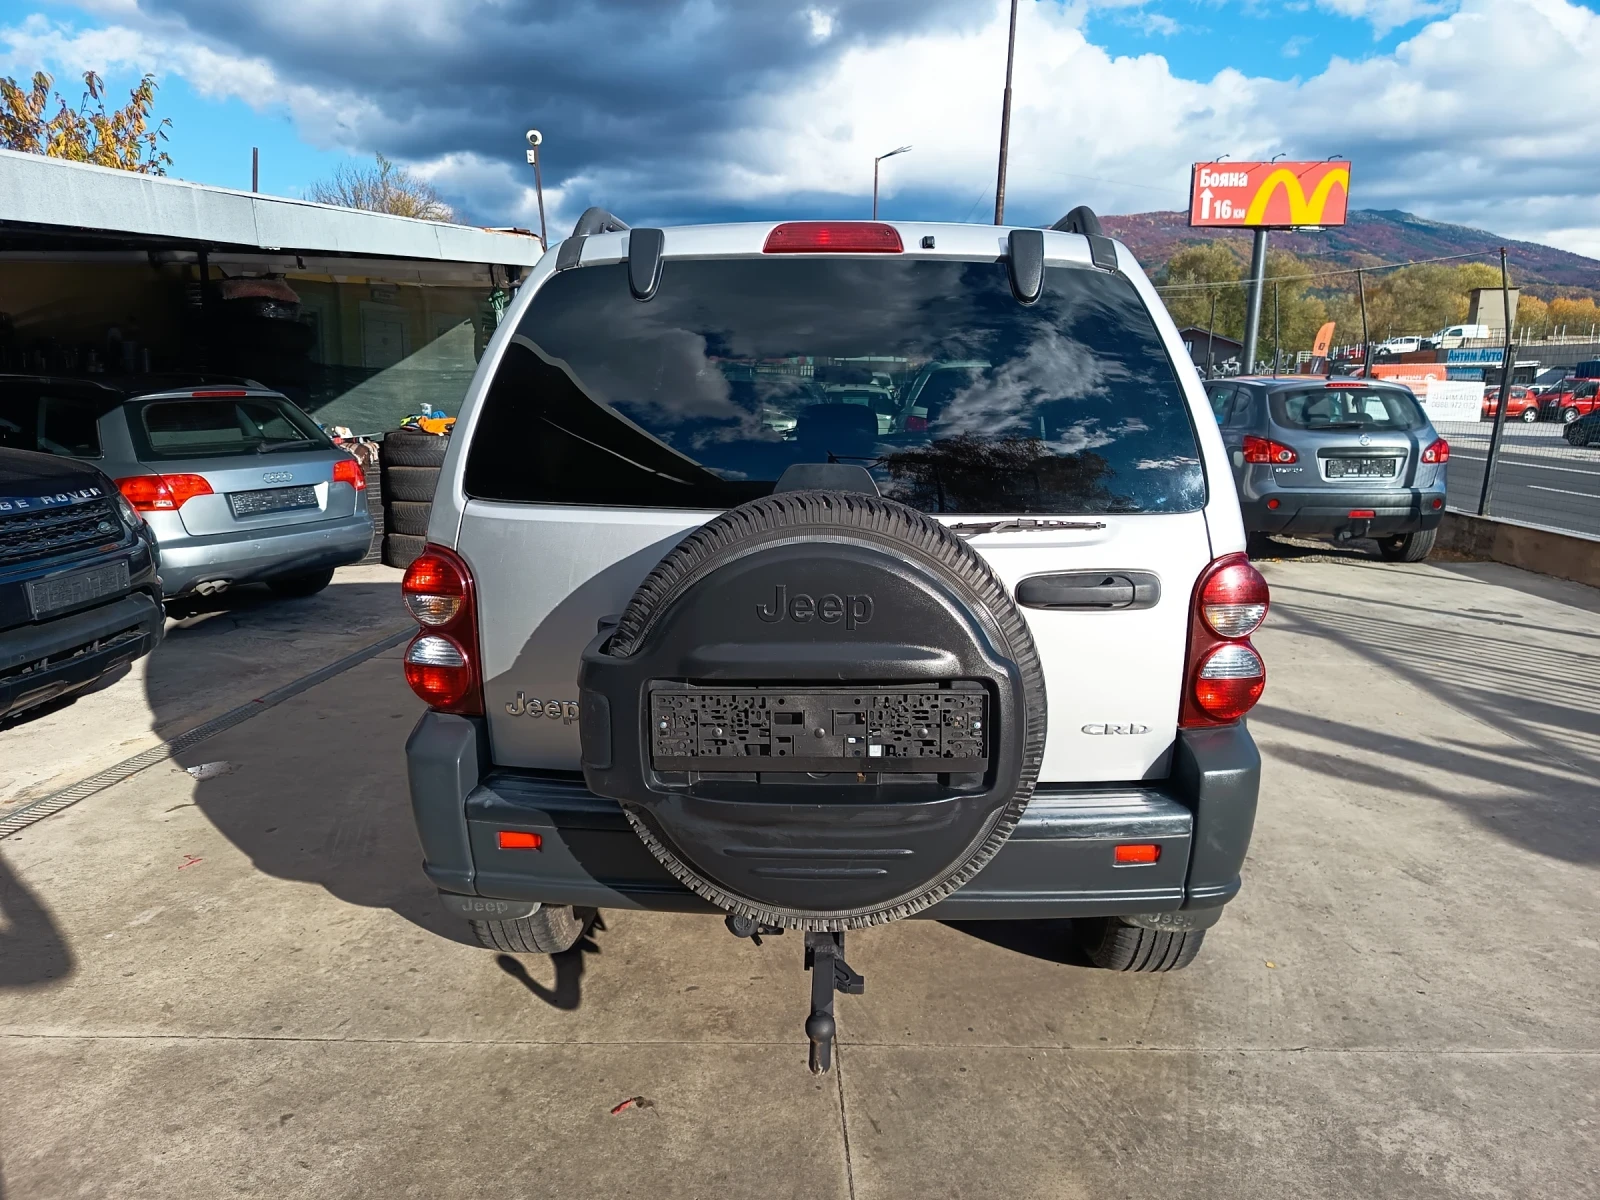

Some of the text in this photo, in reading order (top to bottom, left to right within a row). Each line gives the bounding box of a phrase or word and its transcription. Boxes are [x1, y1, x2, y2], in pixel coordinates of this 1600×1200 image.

[1200, 169, 1248, 187] Бояна
[1214, 200, 1246, 219] 16 км
[1448, 349, 1503, 362] Антим Ауто
[41, 487, 101, 505] ROVER
[756, 584, 875, 631] Jeep
[505, 691, 580, 725] Jeep
[1081, 723, 1153, 735] CRD
[462, 899, 508, 914] Jeep
